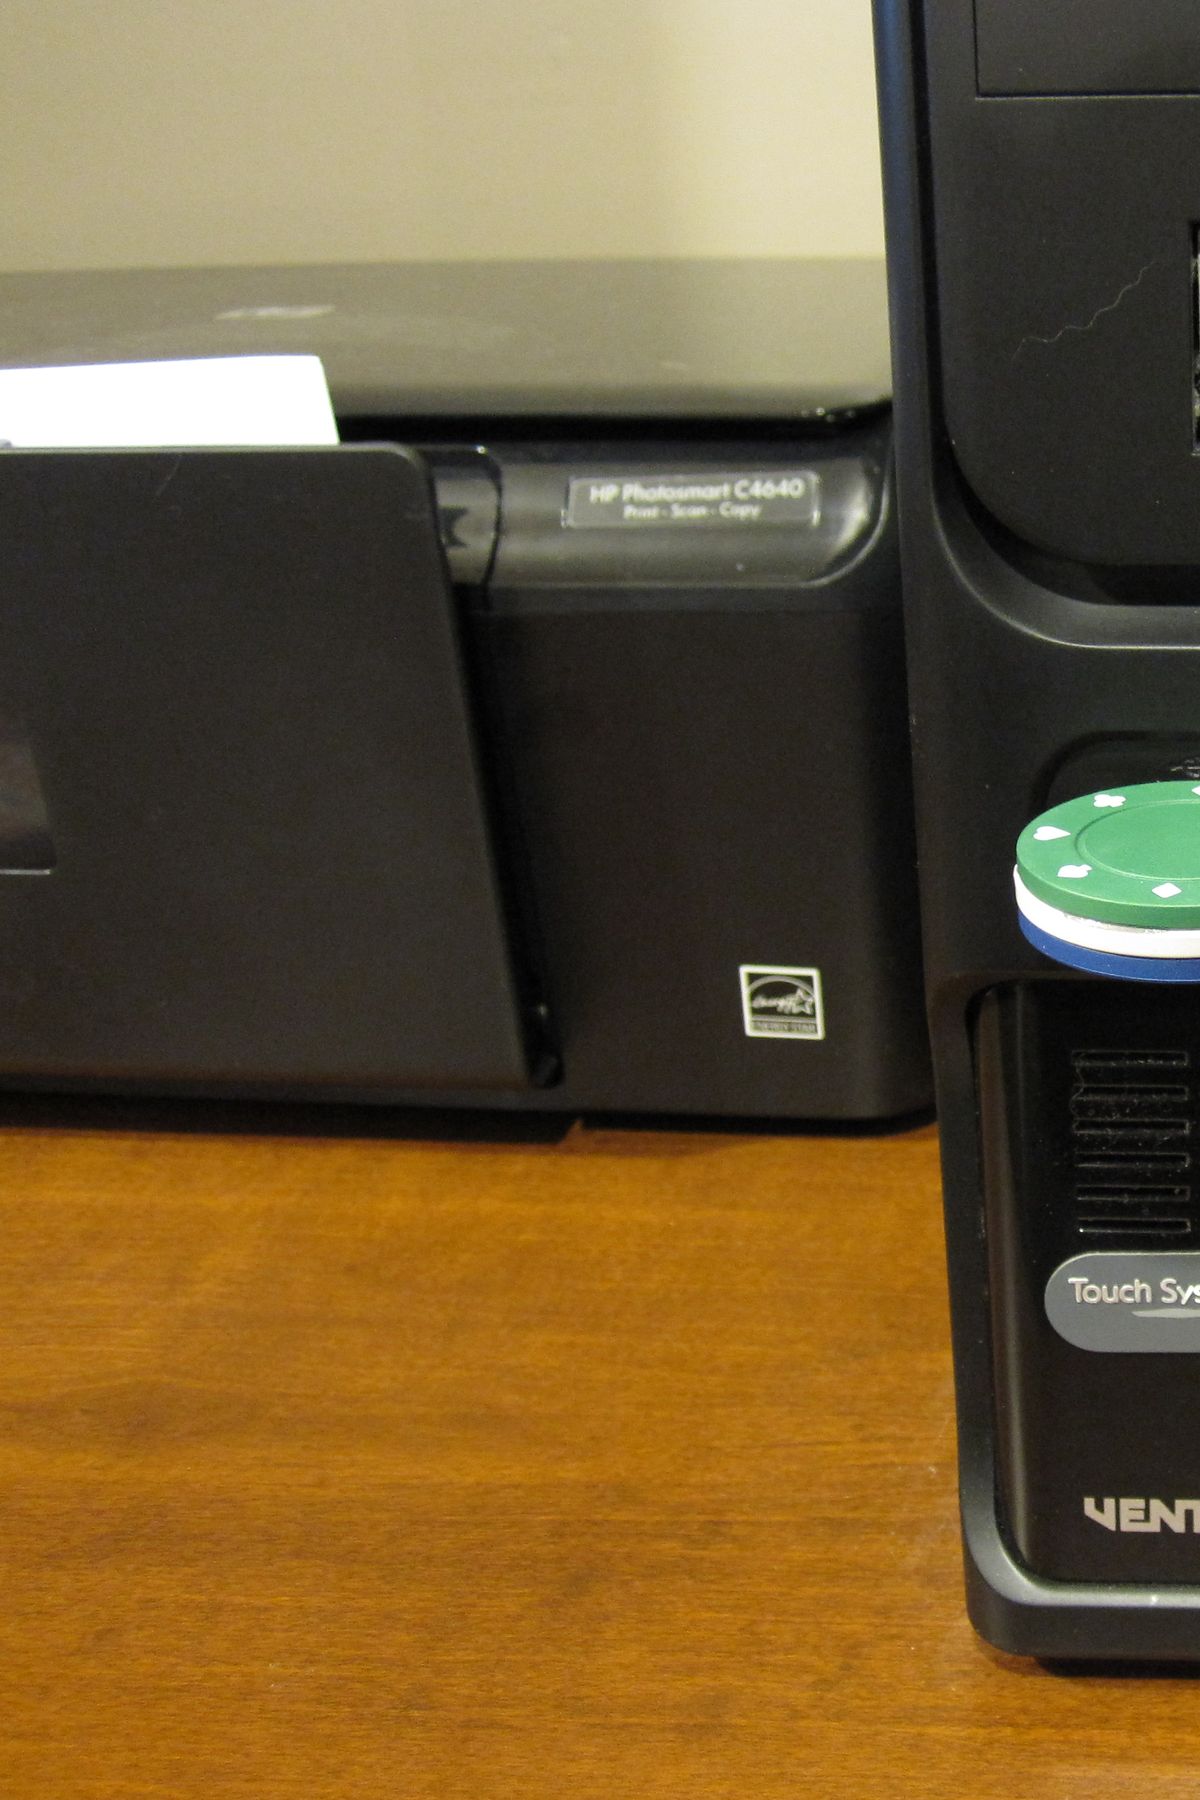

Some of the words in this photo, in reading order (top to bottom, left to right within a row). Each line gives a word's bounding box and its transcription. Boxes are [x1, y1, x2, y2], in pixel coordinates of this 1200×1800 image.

[590, 484, 619, 502] HP
[621, 482, 730, 501] Photosmart
[733, 478, 805, 500] C4640
[718, 501, 761, 519] Copy
[1067, 1276, 1152, 1305] Touch
